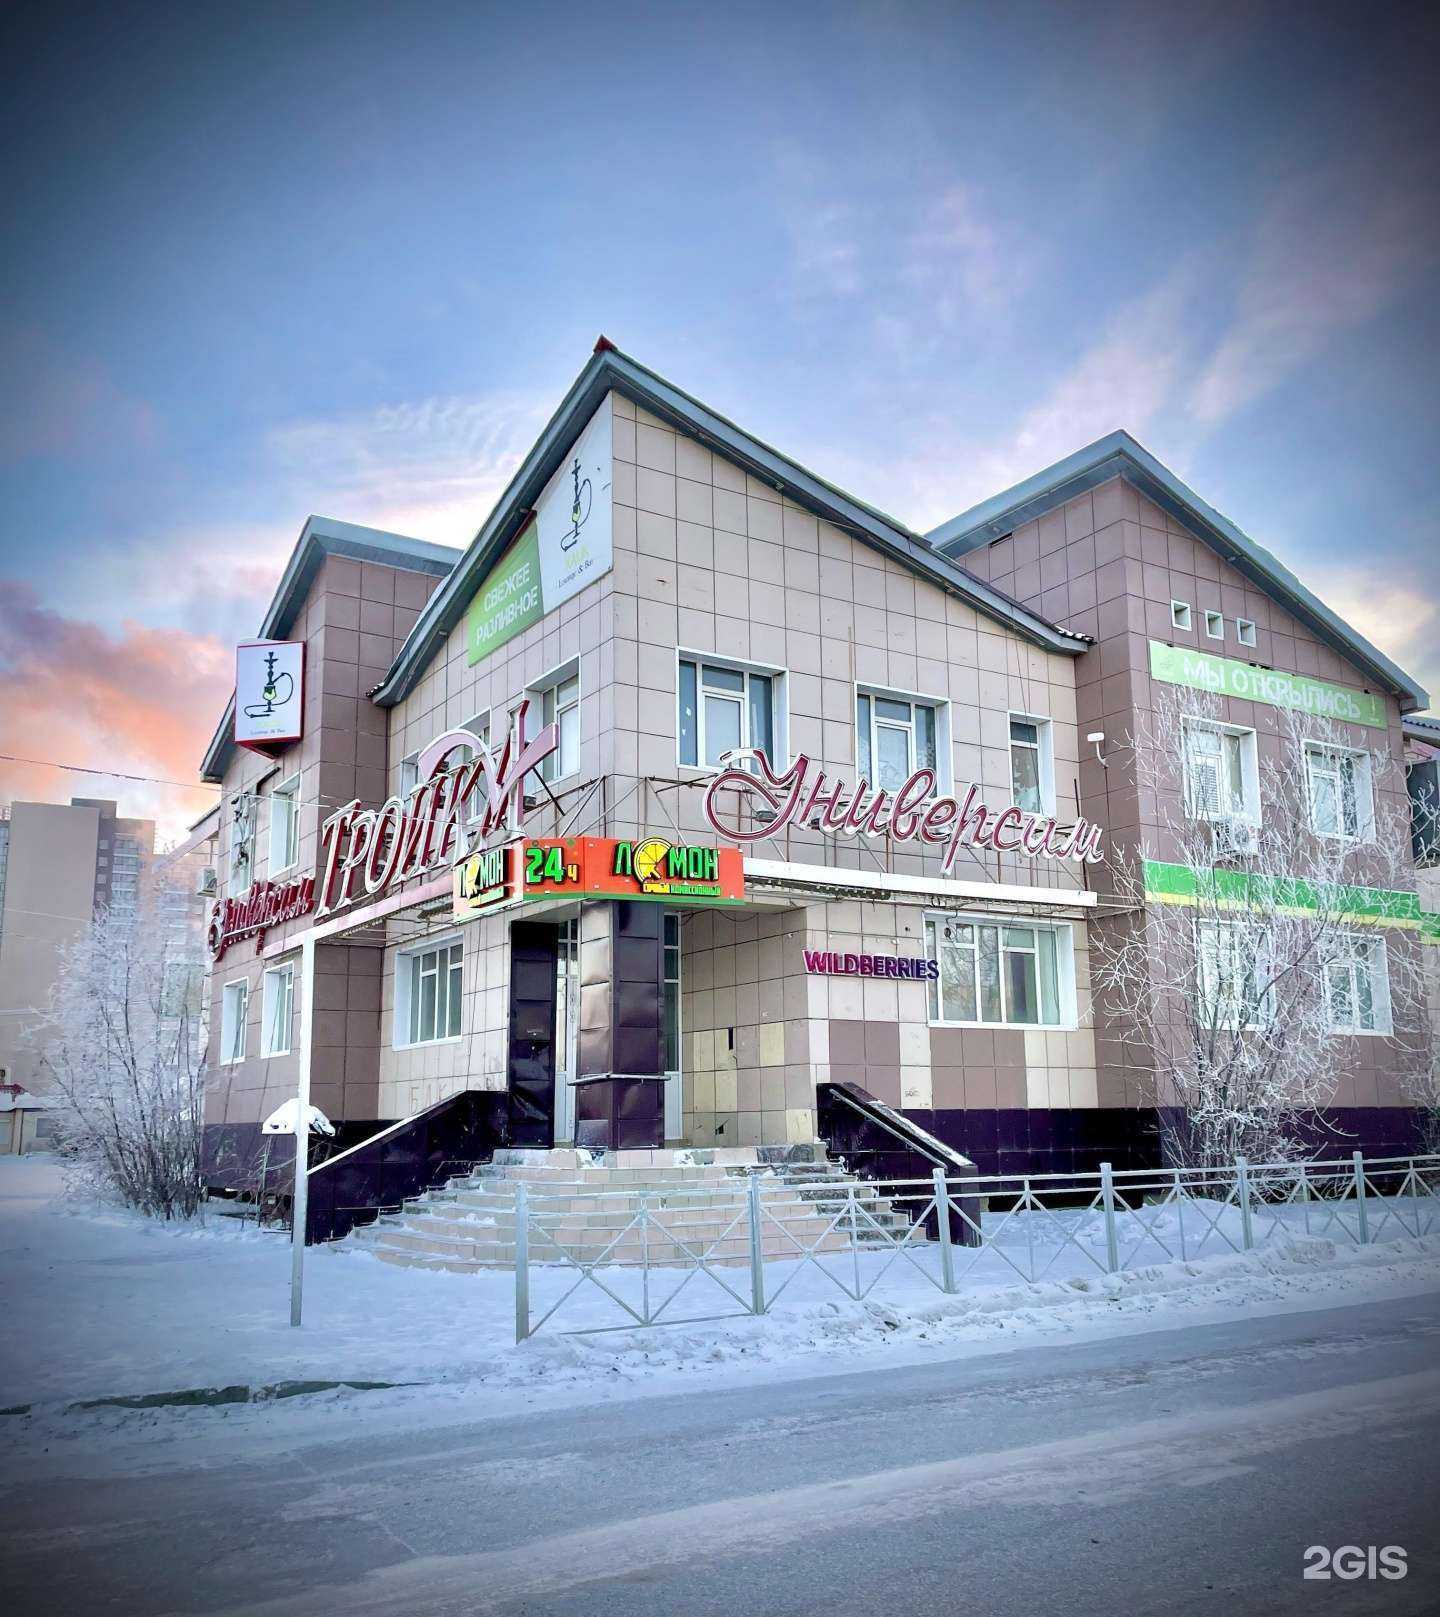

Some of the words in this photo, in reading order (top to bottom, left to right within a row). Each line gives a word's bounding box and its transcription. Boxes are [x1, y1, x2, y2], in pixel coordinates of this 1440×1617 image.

[476, 584, 539, 648] РАЗЛИВНОЕ
[484, 561, 531, 613] СВЕЖЕЕ
[1183, 655, 1225, 689] МЫ
[1231, 667, 1361, 719] ОТКРЫЛИСЬ
[802, 949, 940, 981] WILDBERRIES
